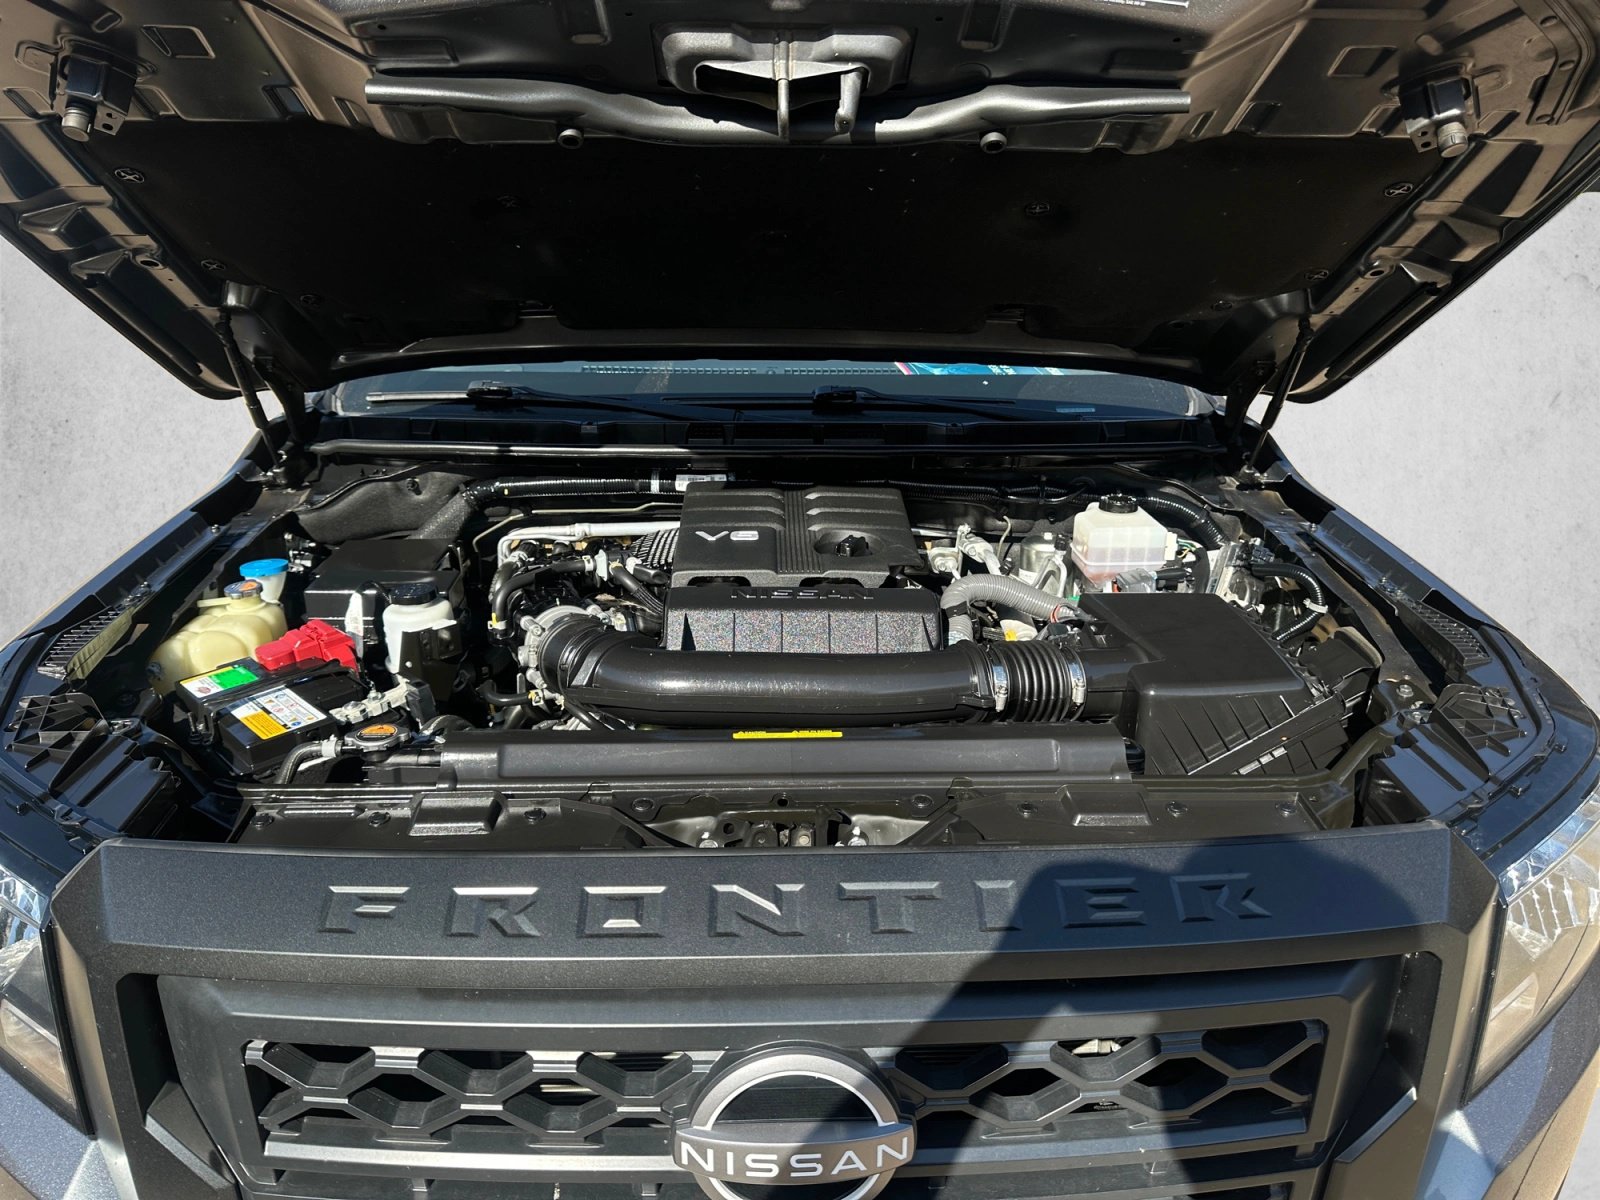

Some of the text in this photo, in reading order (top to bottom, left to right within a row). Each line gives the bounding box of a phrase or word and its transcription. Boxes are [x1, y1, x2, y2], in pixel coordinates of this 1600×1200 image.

[695, 530, 760, 541] V6
[730, 588, 875, 600] NISSAN
[318, 871, 1272, 937] FRONTIER
[680, 1136, 909, 1178] NISSAN
